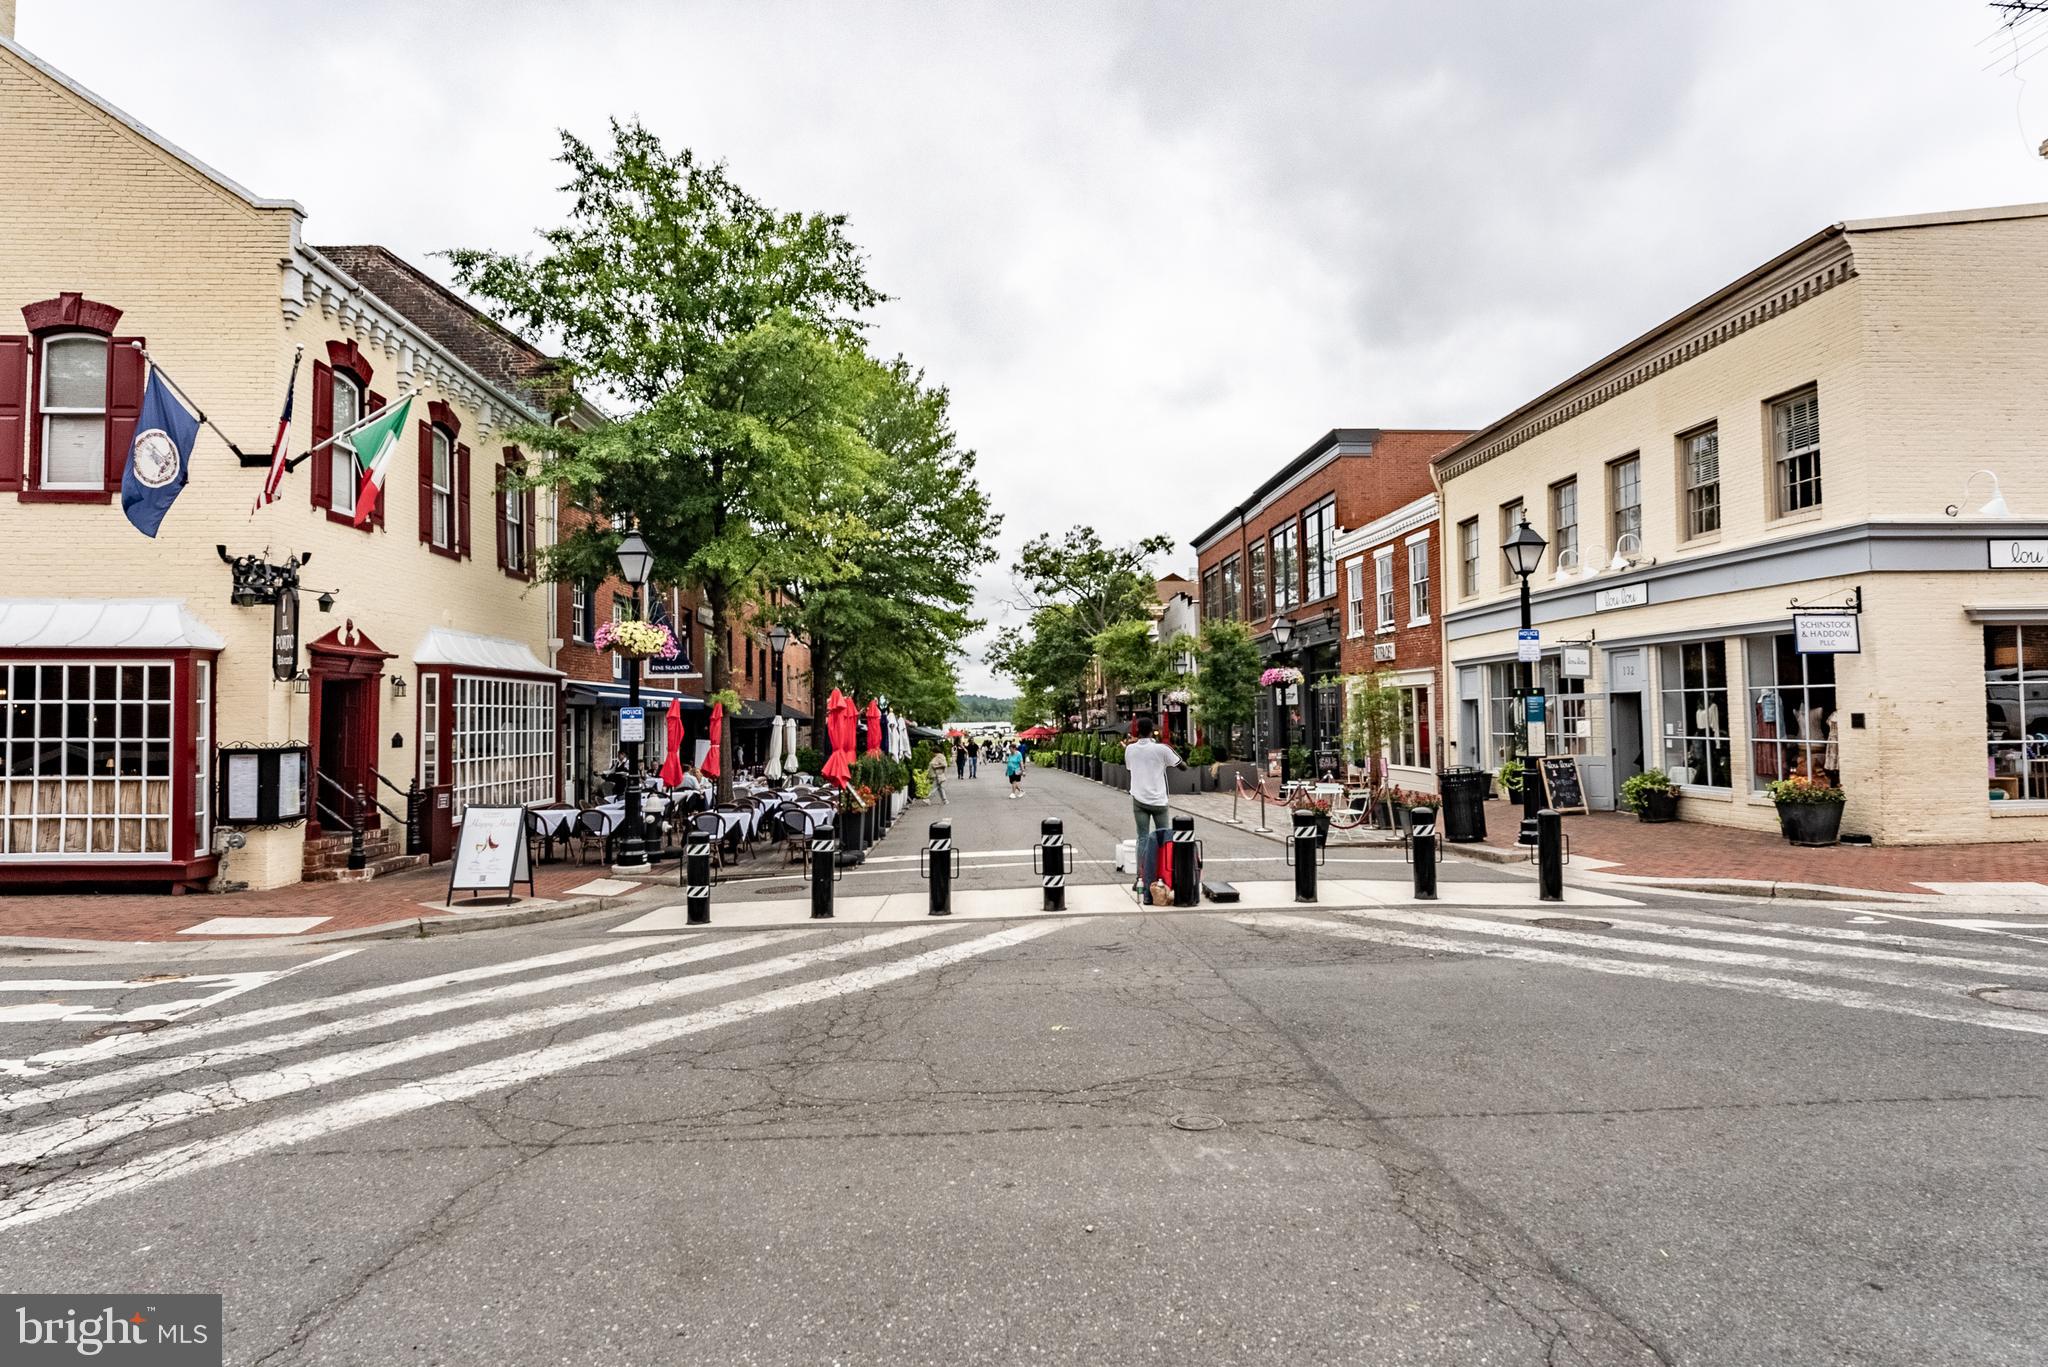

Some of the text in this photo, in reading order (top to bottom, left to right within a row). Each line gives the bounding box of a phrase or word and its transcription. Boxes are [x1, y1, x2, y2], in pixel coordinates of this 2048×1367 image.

[2011, 541, 2044, 563] lou
[282, 615, 288, 630] IL
[1800, 621, 1852, 629] SCHINSTOCK
[1801, 630, 1809, 638] &
[276, 634, 294, 650] PORTO
